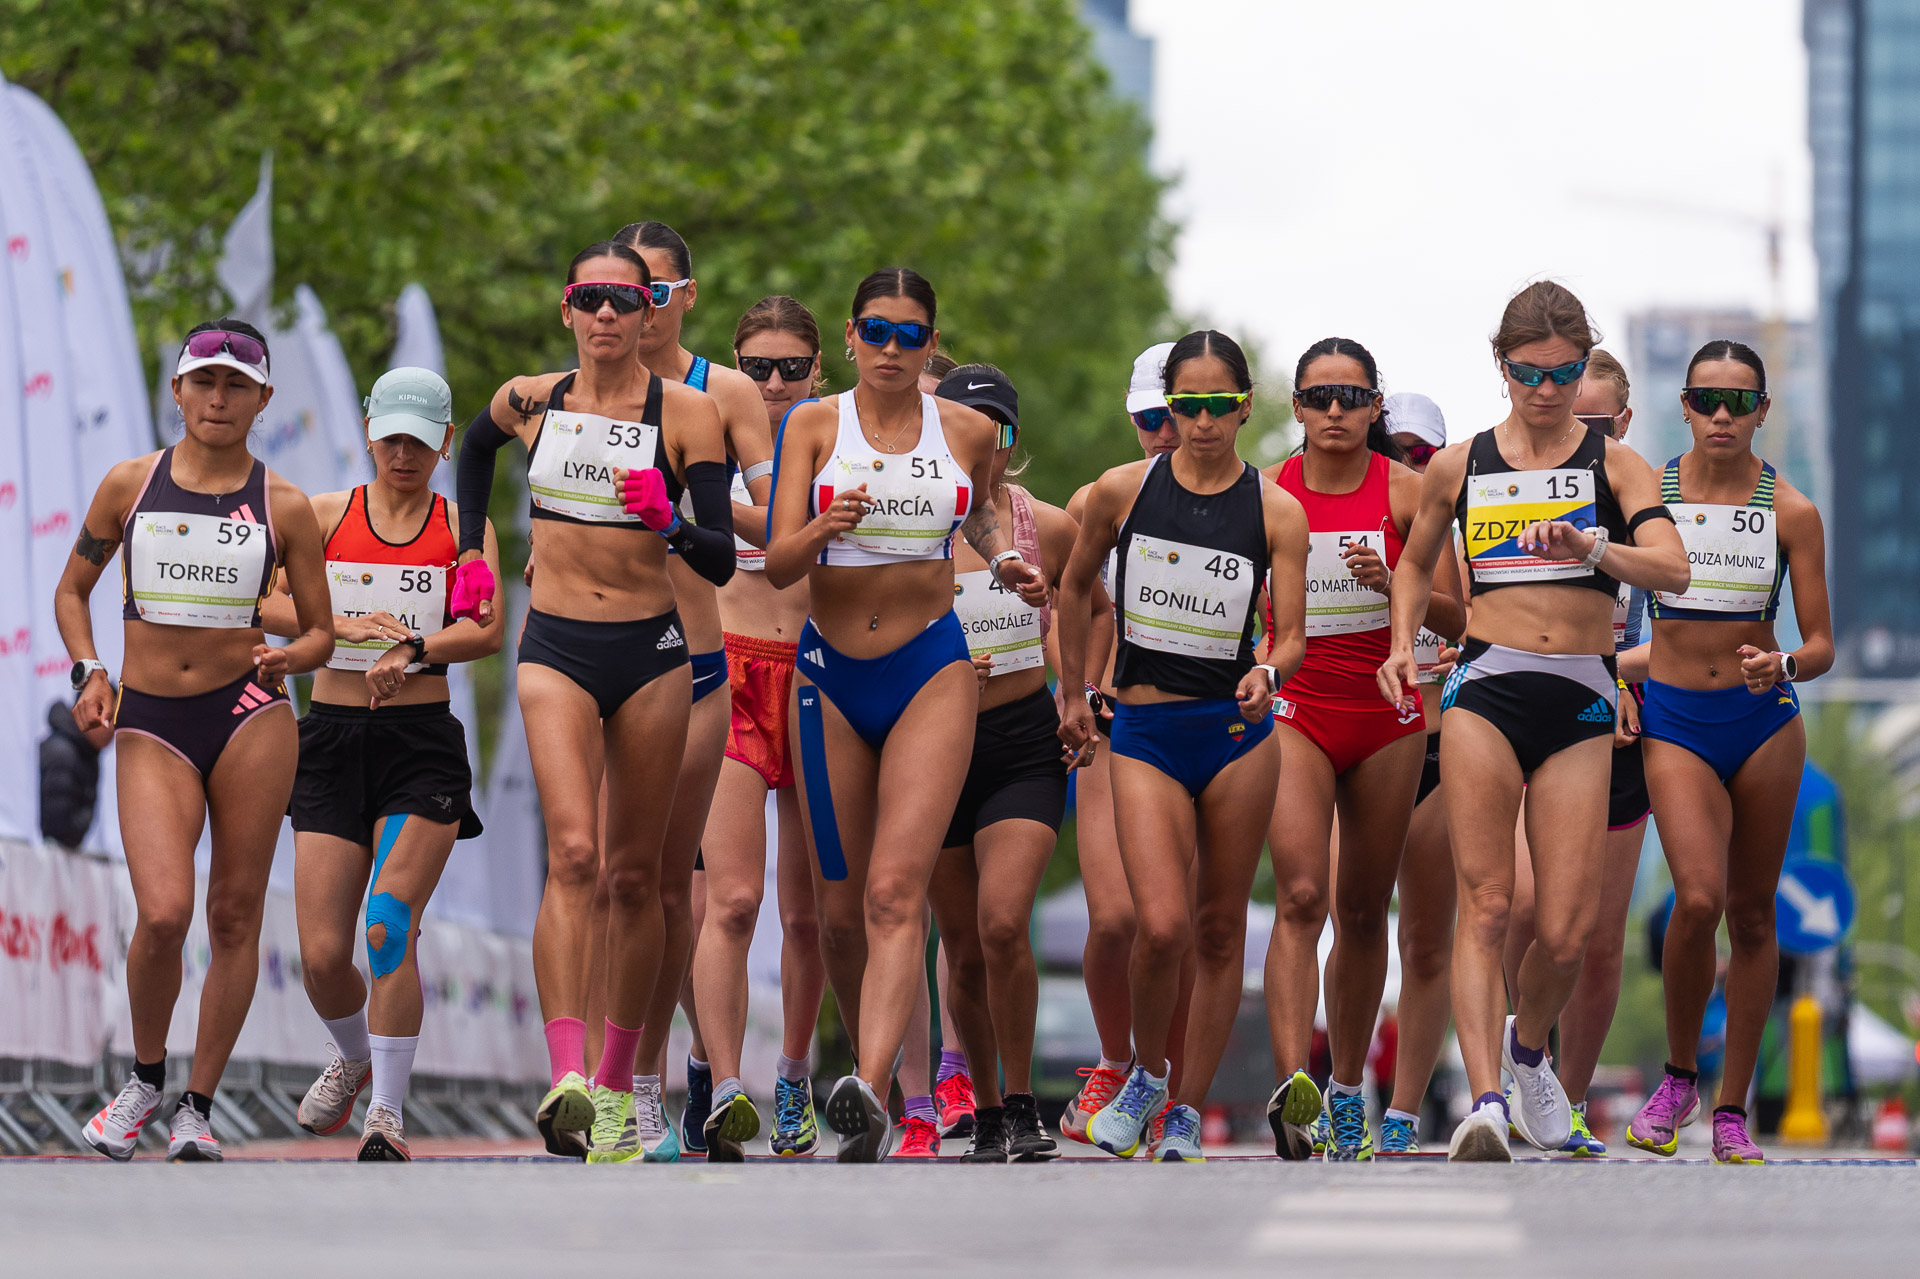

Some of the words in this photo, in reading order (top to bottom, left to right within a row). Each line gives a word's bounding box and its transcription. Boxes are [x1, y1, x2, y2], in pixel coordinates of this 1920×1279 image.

[398, 394, 428, 404] KIPRUN
[606, 424, 641, 448] 53
[563, 461, 611, 484] LYRA
[911, 457, 943, 479] 51
[1546, 475, 1579, 499] 15
[1472, 516, 1591, 542] ZDZIO
[1731, 510, 1765, 534] 50
[217, 522, 252, 546] 59
[1204, 555, 1240, 581] 48
[1687, 551, 1722, 566] OUZA
[1725, 554, 1766, 570] MUNIZ
[156, 562, 239, 584] TORRES
[399, 570, 432, 594] 58
[1139, 586, 1227, 618] BONILLA
[971, 612, 1034, 634] GONZÁLEZ
[656, 638, 684, 650] adidas
[1577, 712, 1612, 722] adidas
